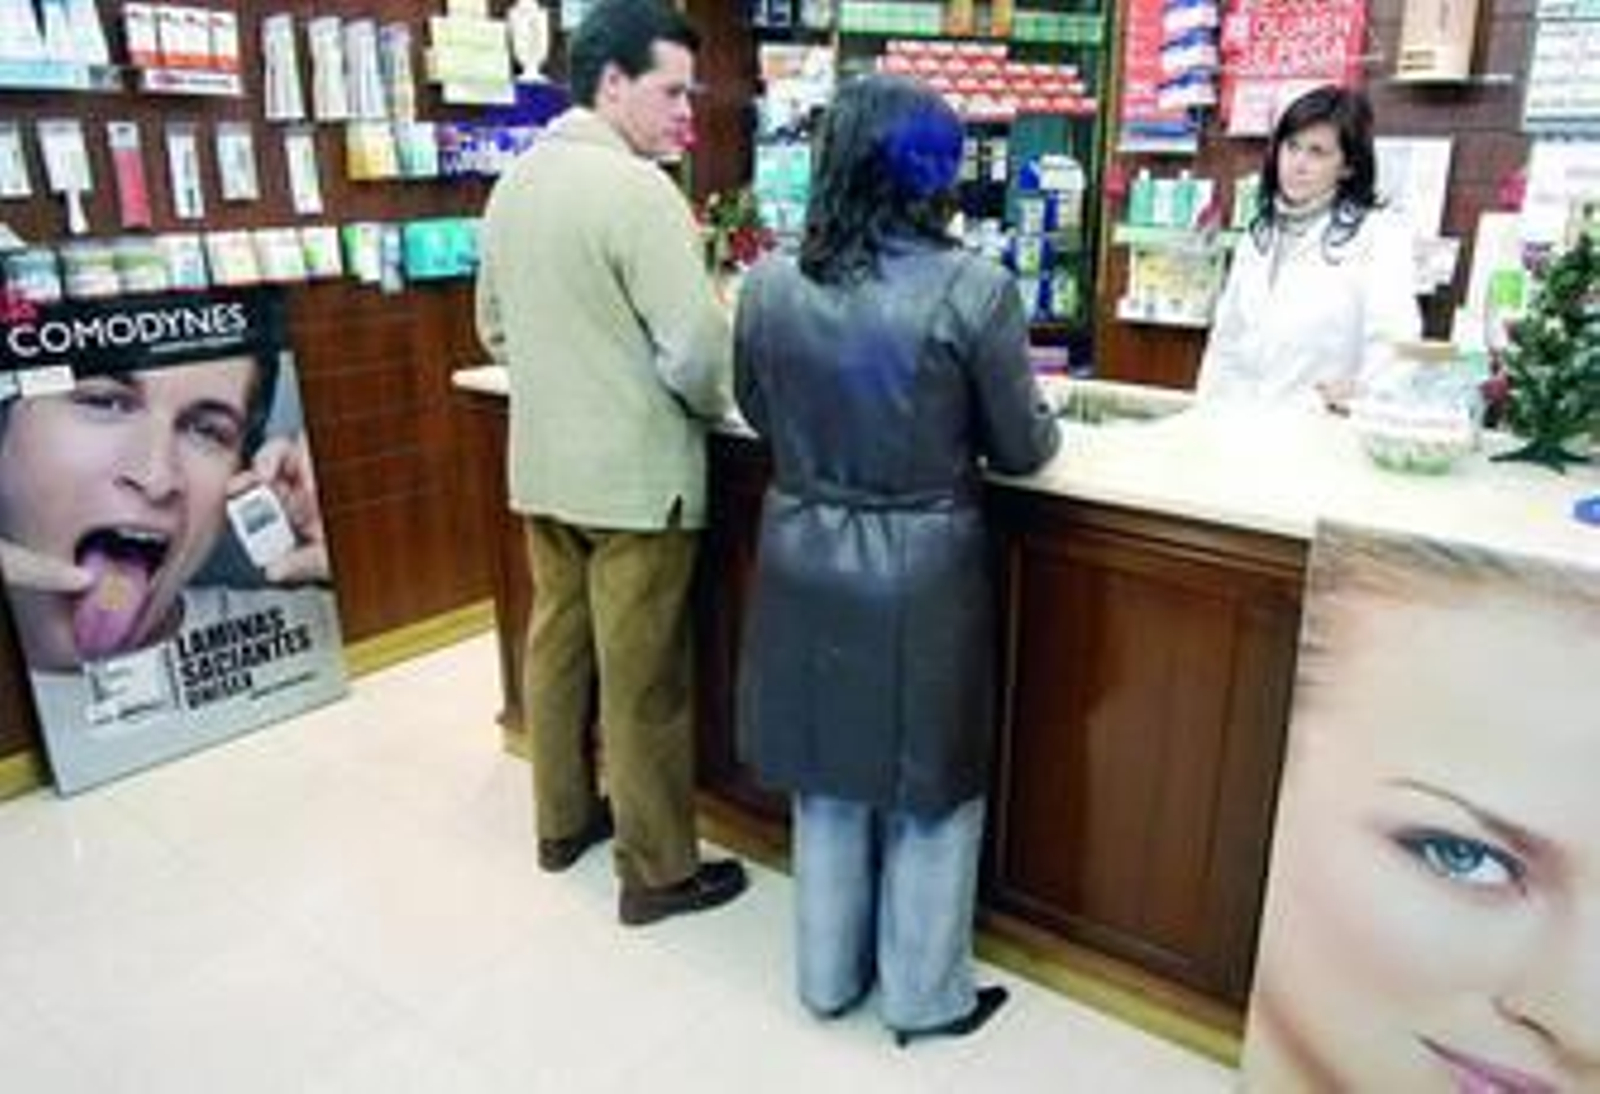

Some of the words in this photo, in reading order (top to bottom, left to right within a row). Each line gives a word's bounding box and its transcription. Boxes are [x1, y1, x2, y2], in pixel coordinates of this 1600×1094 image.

[8, 302, 248, 357] COMODYNES
[178, 606, 285, 659] LAMINAS
[180, 624, 314, 687] SACIANTES
